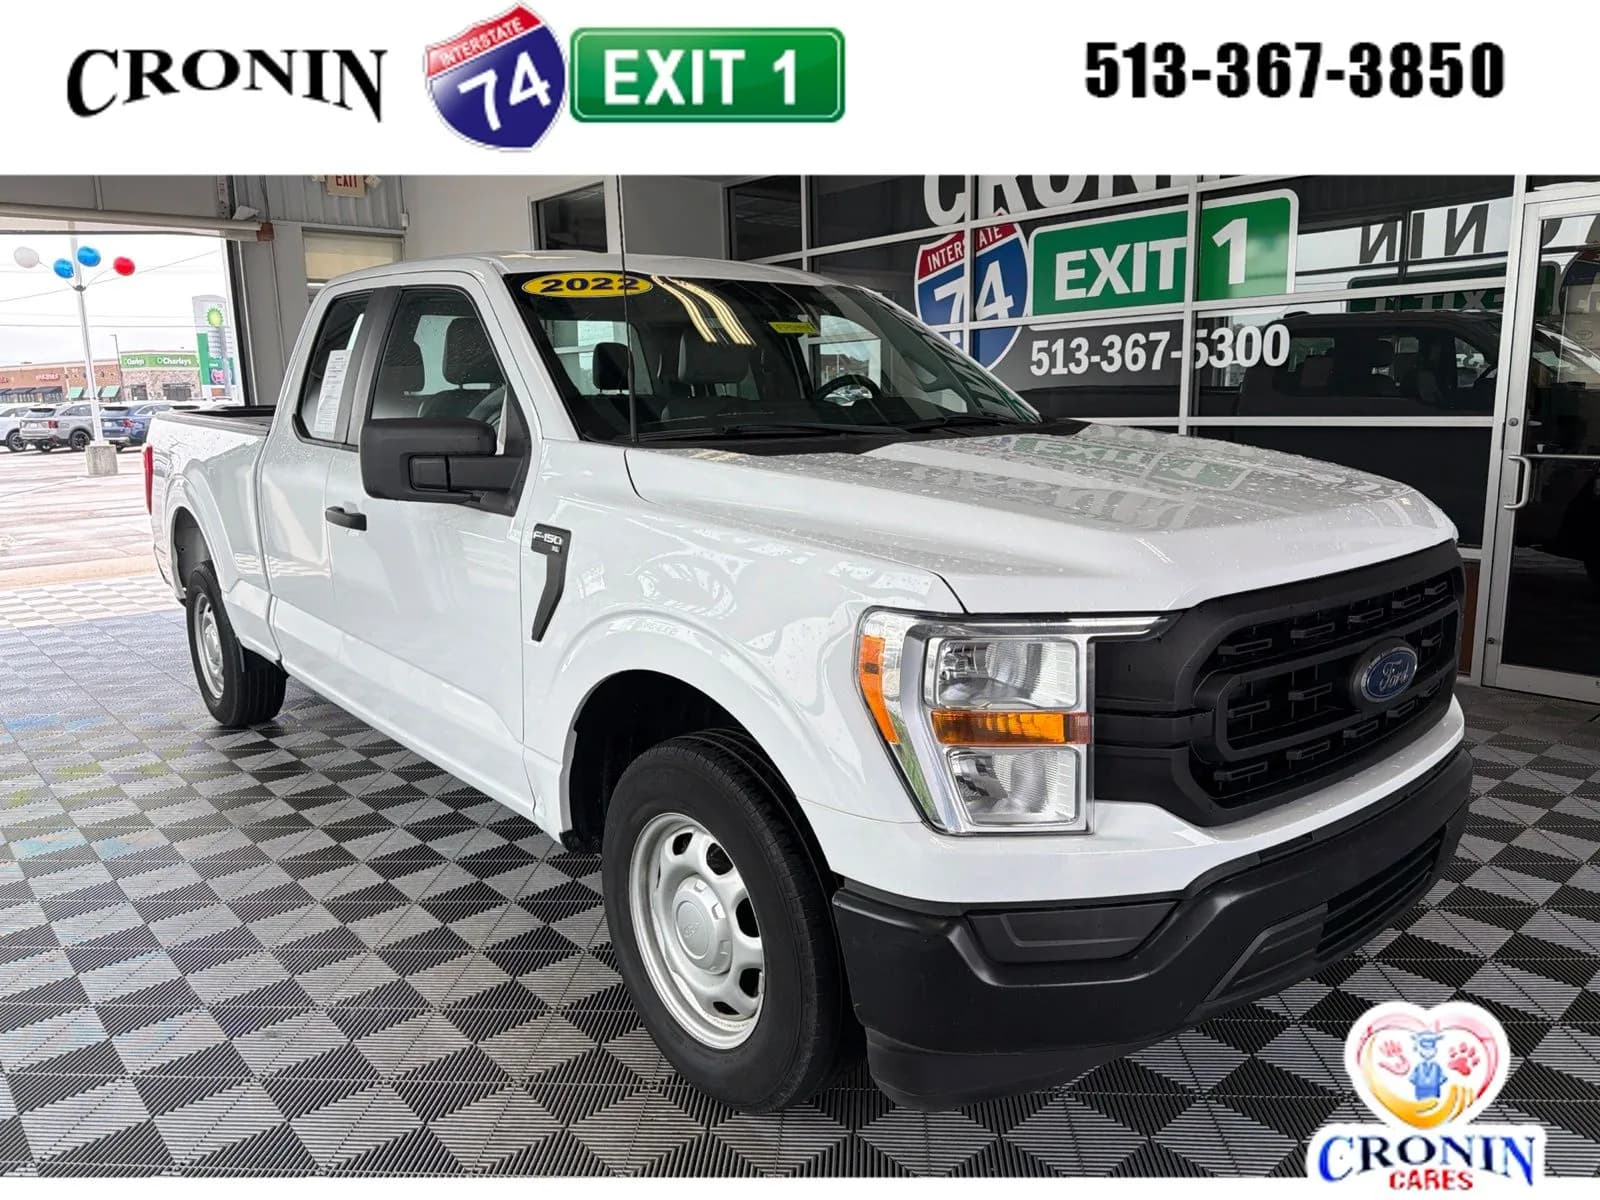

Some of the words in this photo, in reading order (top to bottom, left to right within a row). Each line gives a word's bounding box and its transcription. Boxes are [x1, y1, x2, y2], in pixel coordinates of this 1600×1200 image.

[927, 226, 1003, 273] INTERATE
[1055, 236, 1187, 301] EXIT
[1212, 217, 1248, 285] 1
[540, 277, 640, 293] 2022
[933, 260, 1015, 346] 74
[1030, 323, 1290, 377] 513-367-5300
[533, 531, 562, 545] F-150
[1379, 660, 1410, 692] Ford
